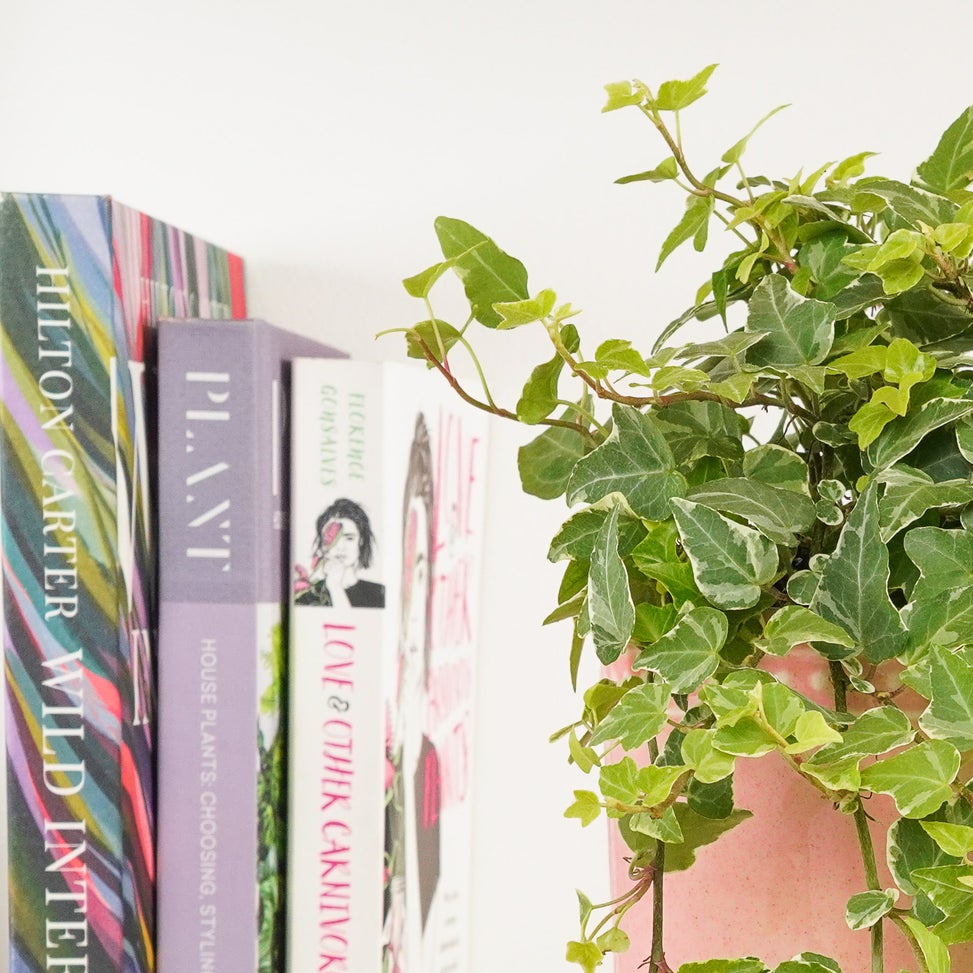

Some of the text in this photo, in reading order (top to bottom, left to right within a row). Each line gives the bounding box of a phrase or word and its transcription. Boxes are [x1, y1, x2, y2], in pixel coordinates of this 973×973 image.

[35, 265, 75, 433] HILTON
[185, 371, 231, 572] PLANT
[40, 448, 79, 622] CARTER
[200, 638, 217, 705] HOUSE
[321, 623, 356, 692] LOVE
[327, 695, 350, 713] &
[40, 647, 85, 796] WILD
[320, 719, 354, 811] OTHER
